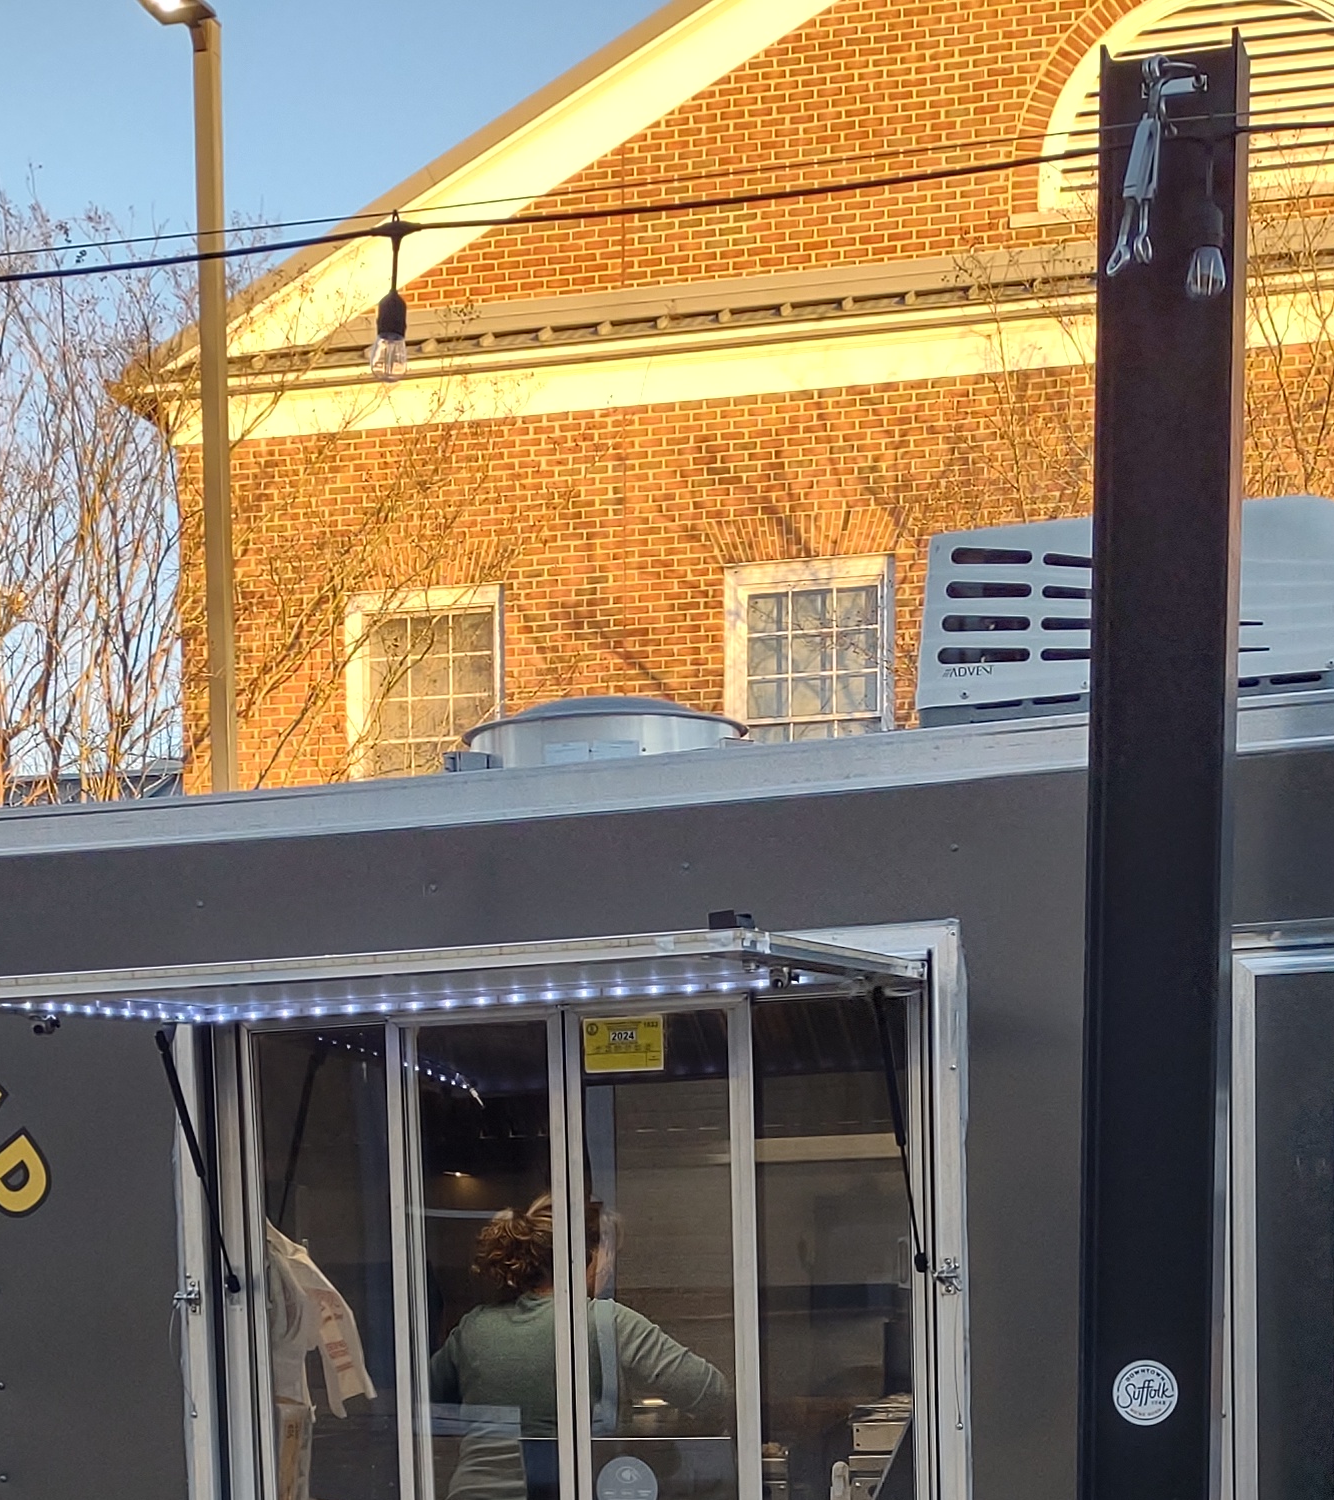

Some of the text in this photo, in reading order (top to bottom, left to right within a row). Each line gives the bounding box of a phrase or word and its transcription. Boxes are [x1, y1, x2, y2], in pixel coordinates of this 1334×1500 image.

[611, 1031, 635, 1041] 2024
[1125, 1368, 1165, 1382] DOWNTOWN
[1117, 1379, 1174, 1408] Suffolk
